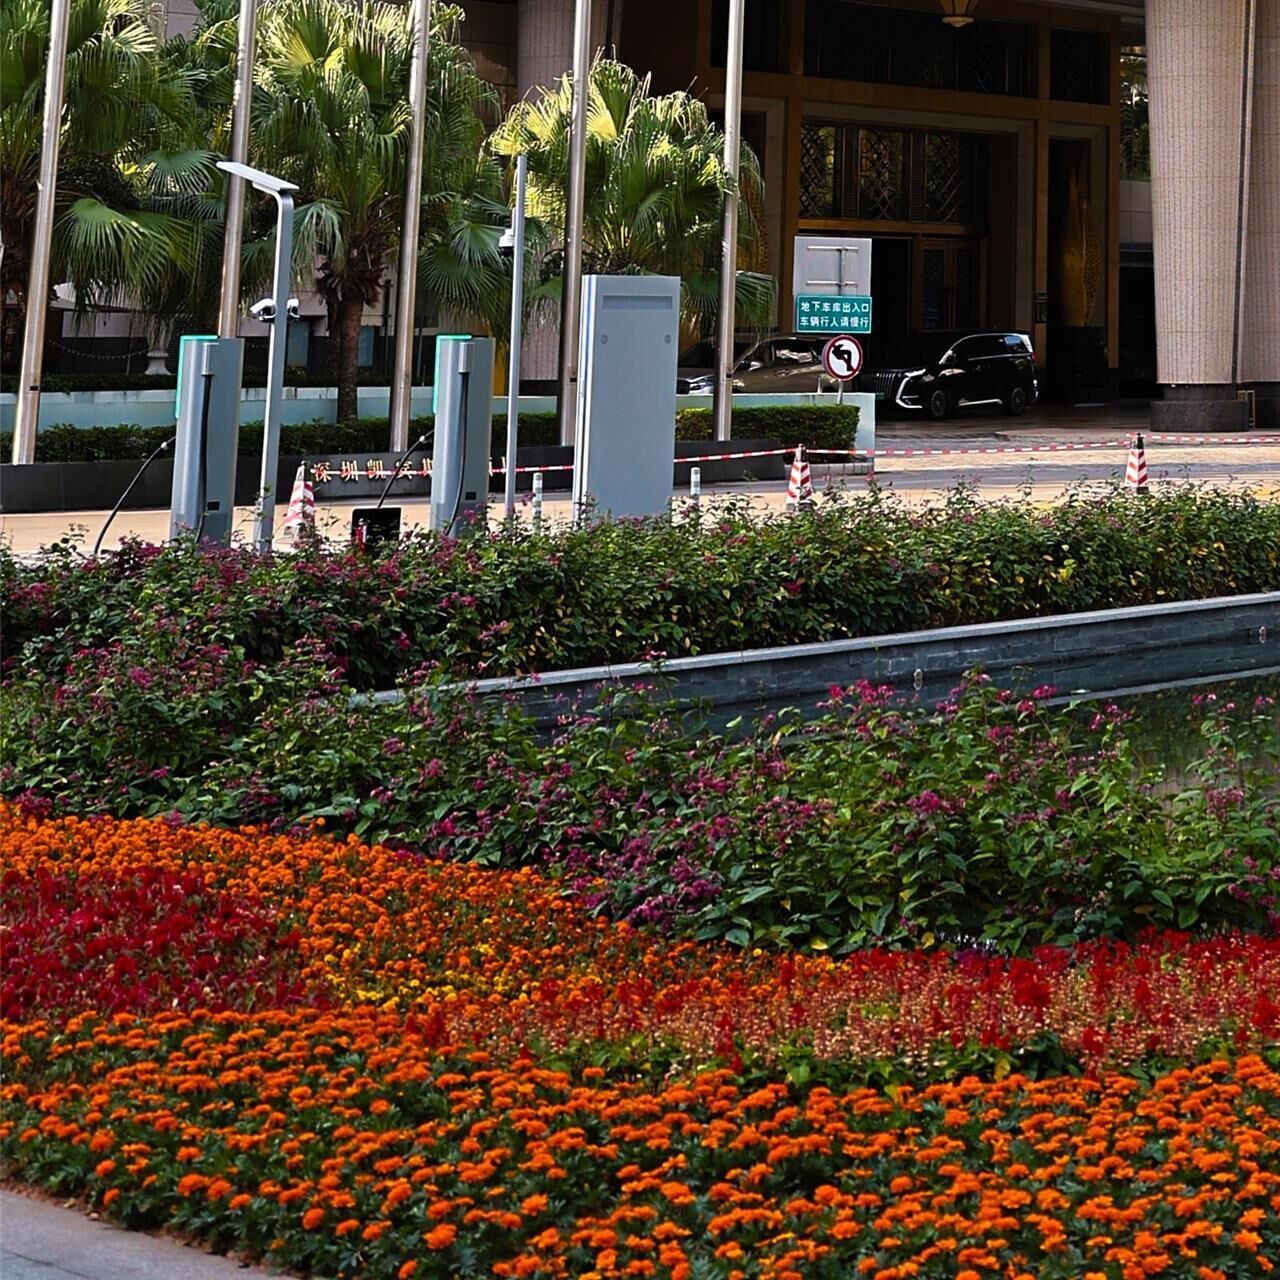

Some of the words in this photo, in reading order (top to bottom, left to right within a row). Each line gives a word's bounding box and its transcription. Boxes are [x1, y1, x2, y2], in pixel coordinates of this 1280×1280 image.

[800, 301, 869, 313] 地下车库出入口
[799, 316, 869, 328] 车辆行人请慢行
